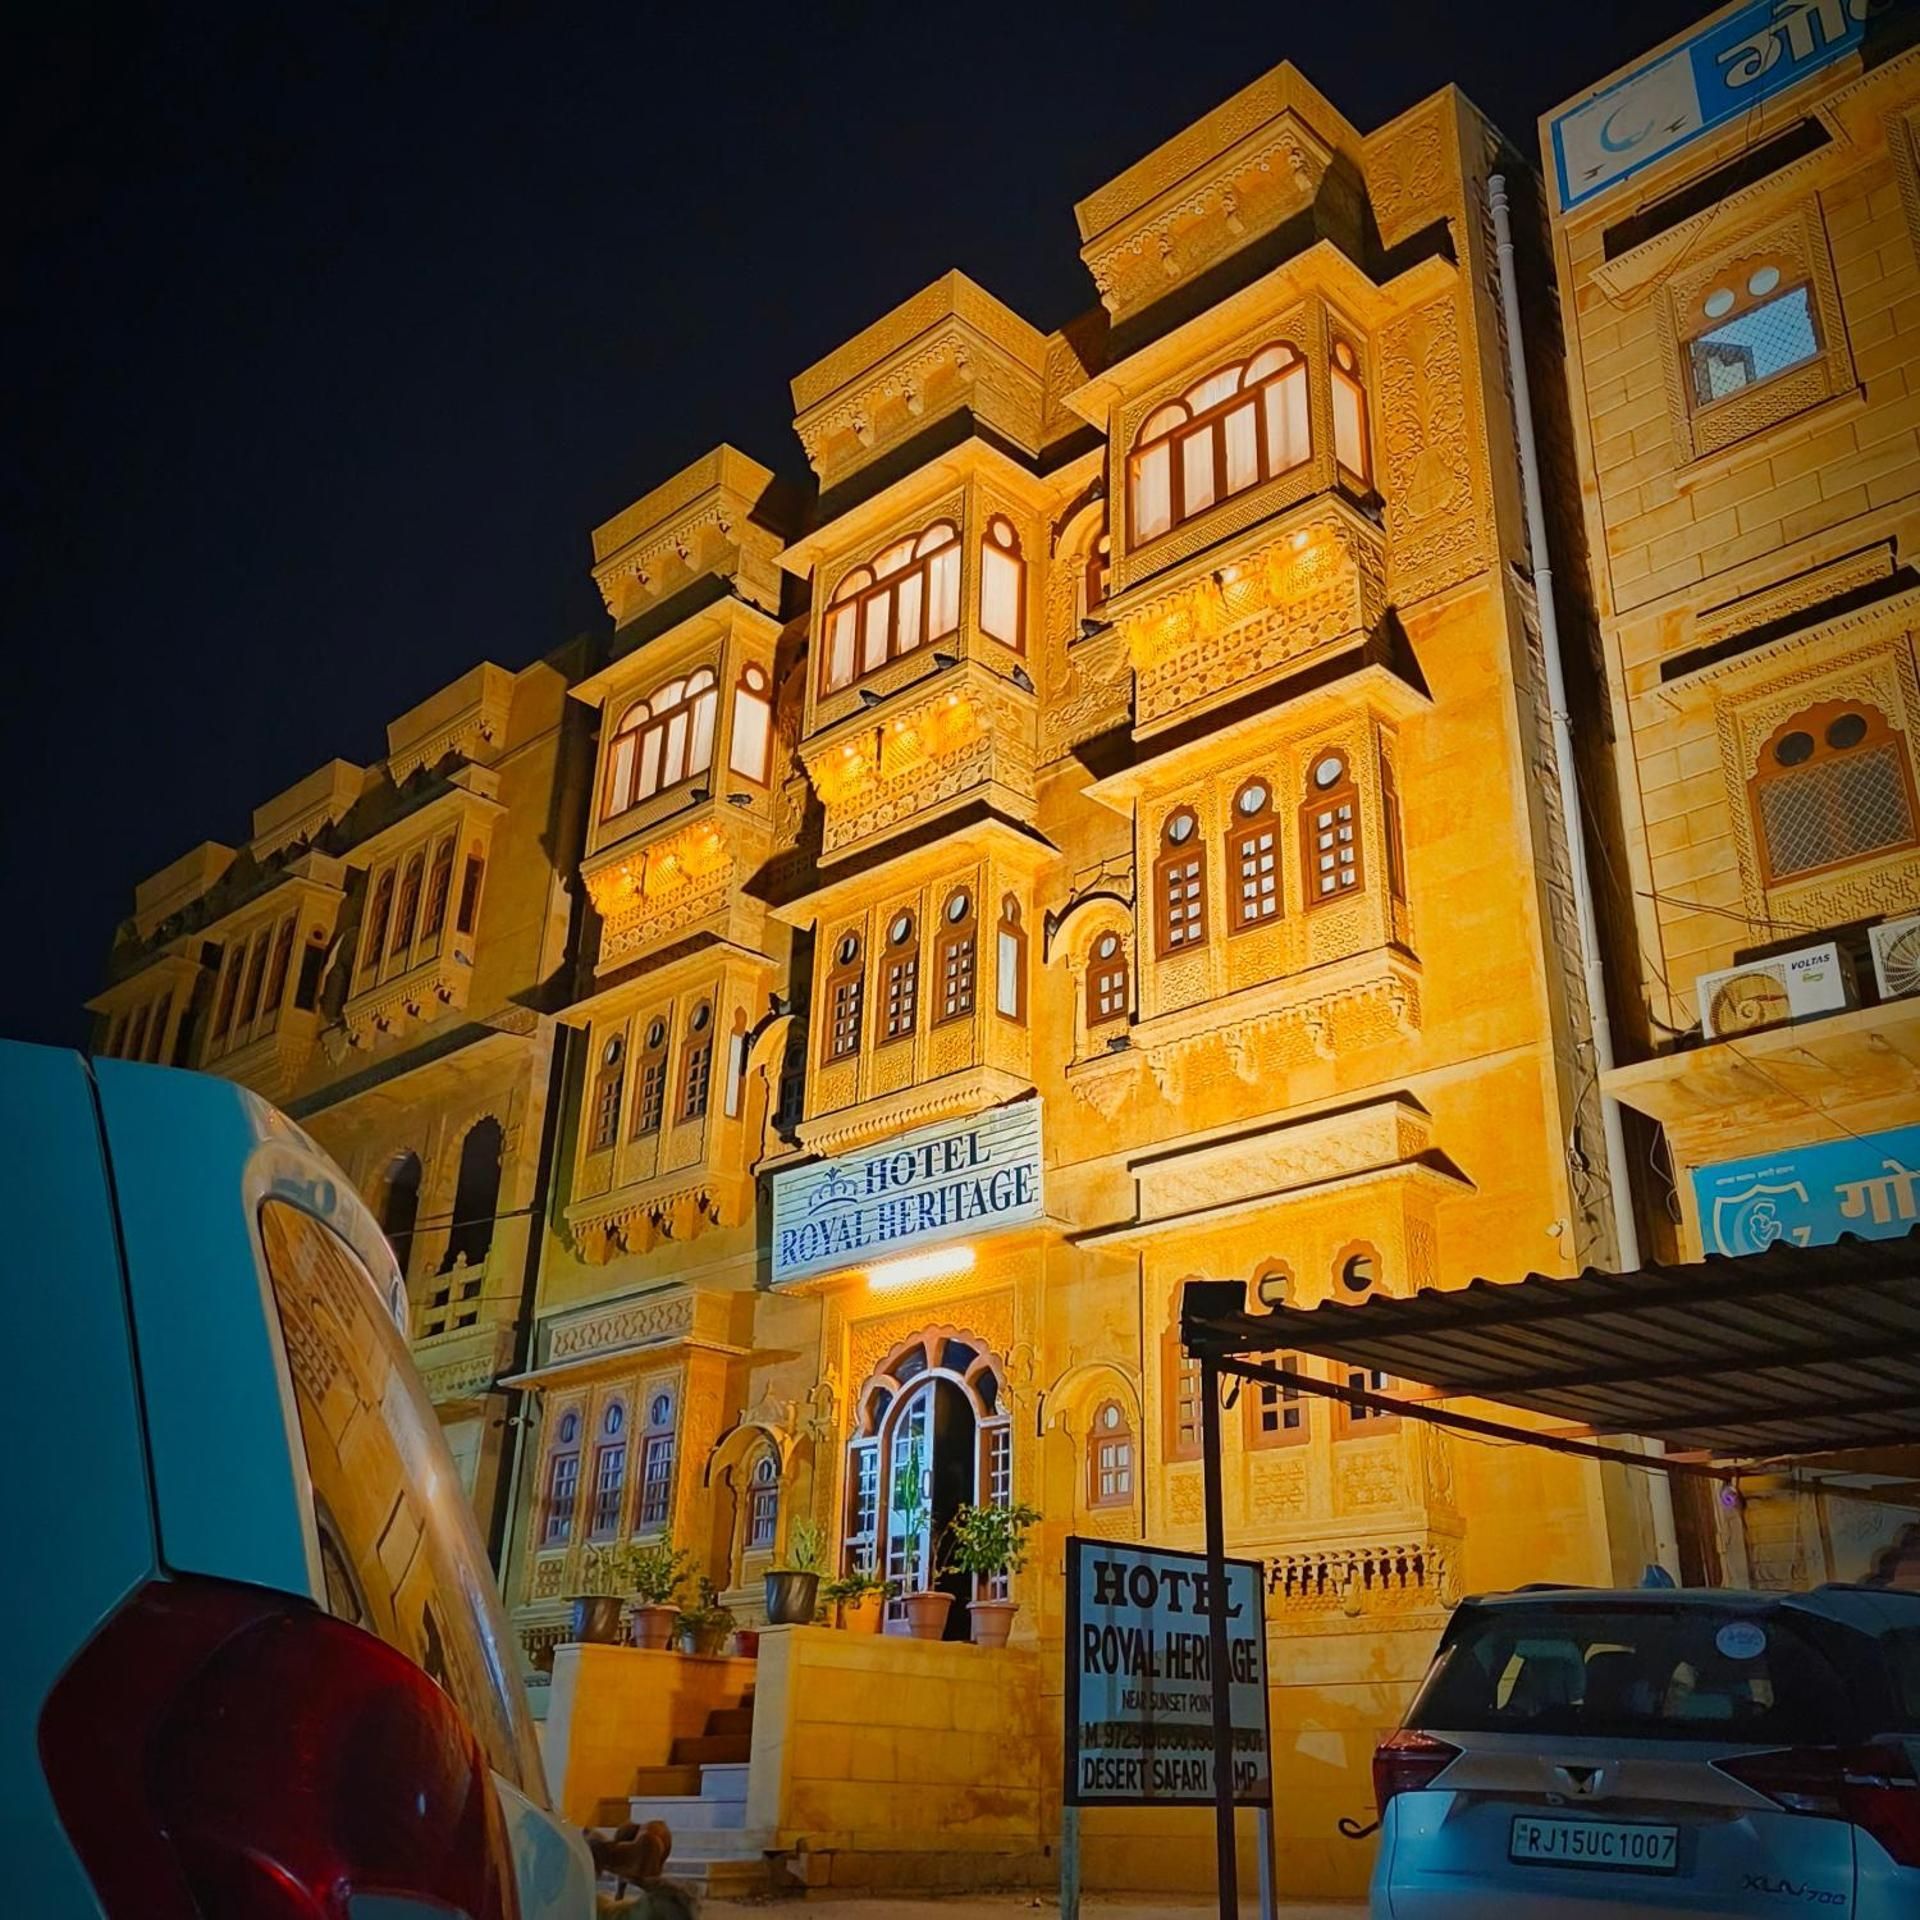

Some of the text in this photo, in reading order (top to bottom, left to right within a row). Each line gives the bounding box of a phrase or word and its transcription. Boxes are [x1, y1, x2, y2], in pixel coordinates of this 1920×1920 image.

[1791, 954, 1831, 970] VOLTAS
[864, 1131, 992, 1195] HOTEL
[1834, 1159, 1920, 1224] गो
[780, 1163, 1034, 1267] ROYAL HERITAGE
[1093, 1560, 1243, 1618] HOTEL
[1083, 1623, 1259, 1684] ROYAL HERIGE
[1122, 1689, 1146, 1711] NEAR
[1150, 1691, 1188, 1713] SUNSET
[1083, 1756, 1258, 1791] DESERT SAFARI MP
[1528, 1826, 1675, 1862] RJ15UC1007
